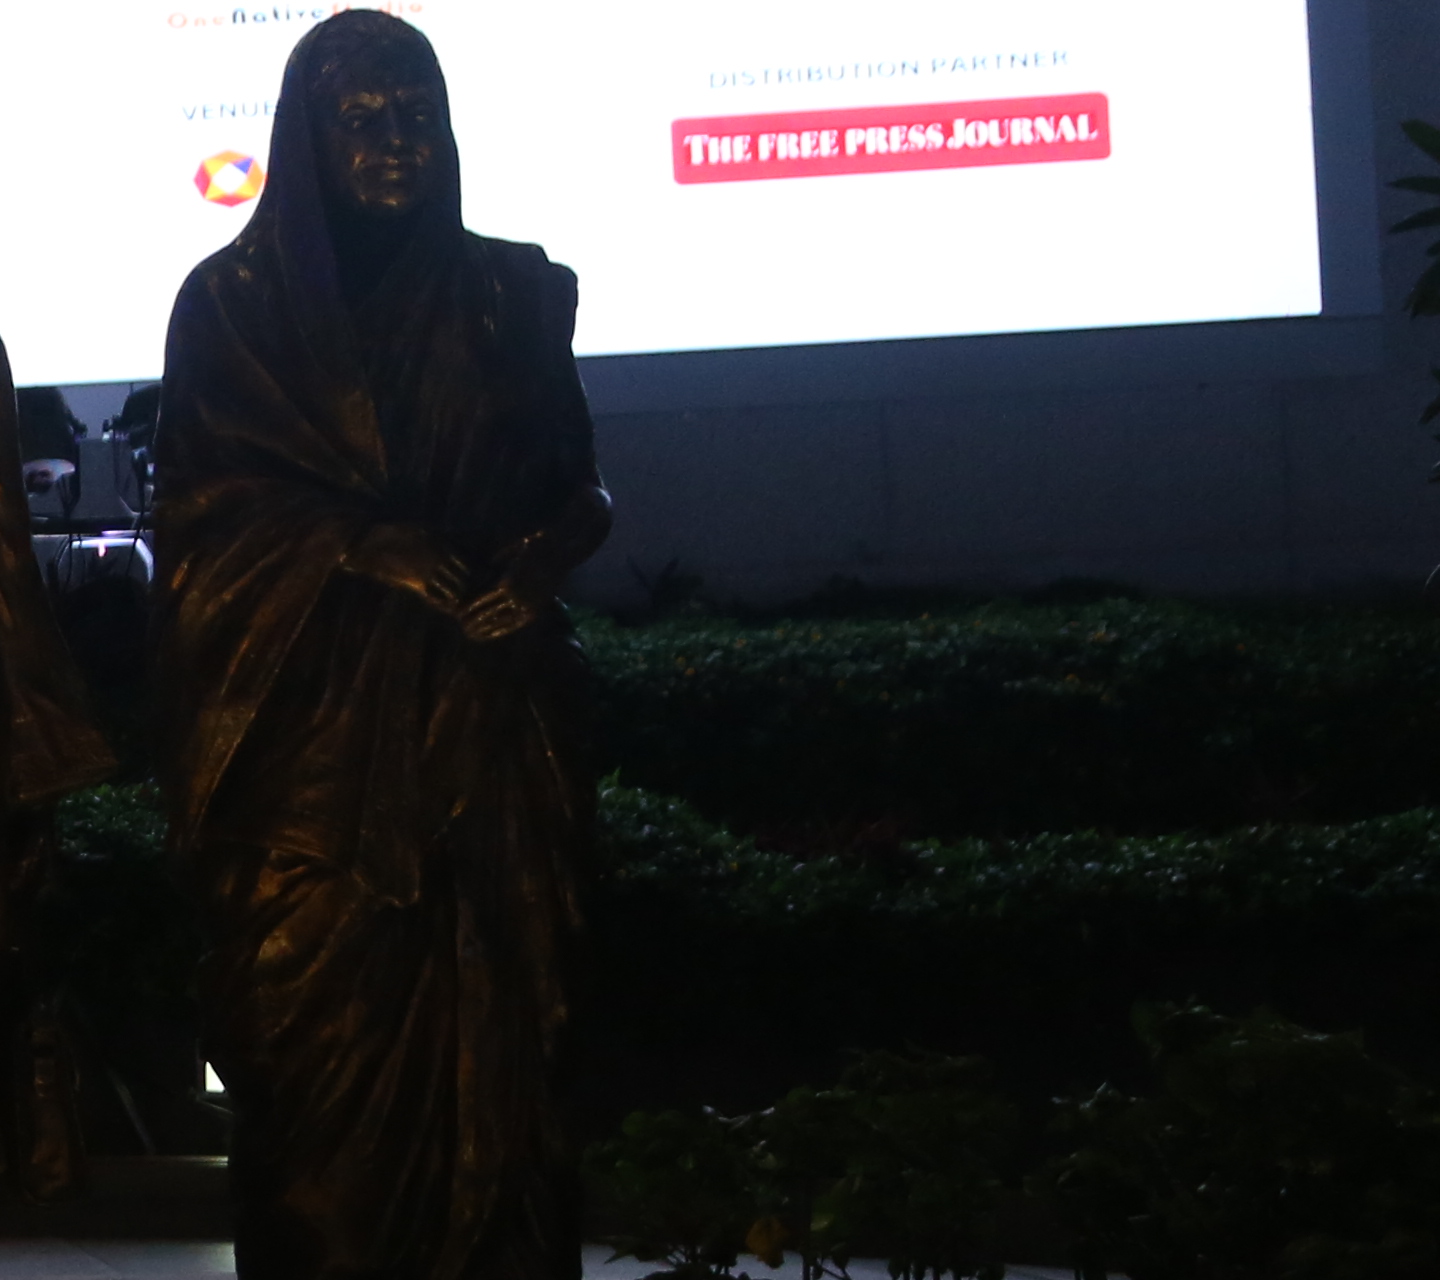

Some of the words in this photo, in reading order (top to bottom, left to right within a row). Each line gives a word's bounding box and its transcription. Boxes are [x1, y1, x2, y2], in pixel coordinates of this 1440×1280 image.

[710, 59, 920, 89] DISTRIBUTION
[930, 49, 1069, 75] PARTNER
[182, 99, 276, 121] VENUE
[683, 133, 752, 166] THE
[758, 128, 839, 162] FREE
[845, 121, 945, 157] PRESS
[946, 112, 1099, 151] JOURNAL
